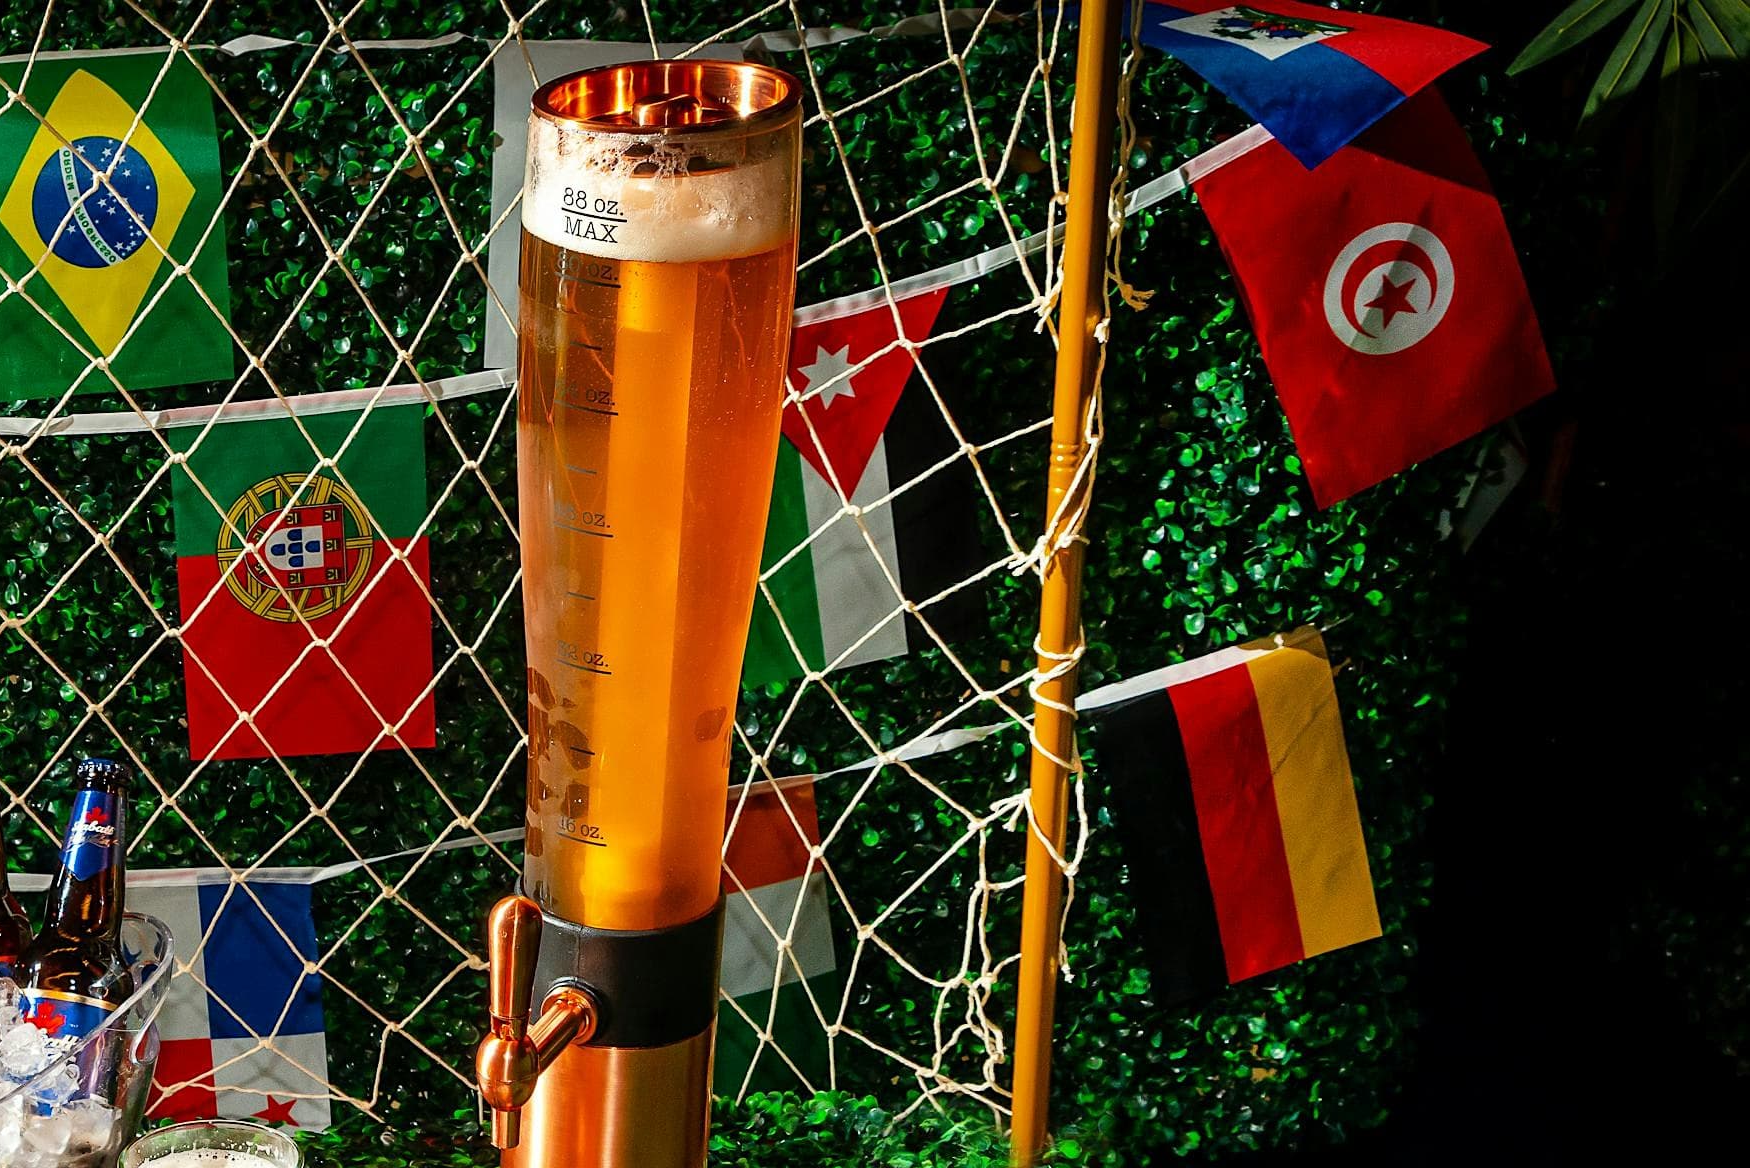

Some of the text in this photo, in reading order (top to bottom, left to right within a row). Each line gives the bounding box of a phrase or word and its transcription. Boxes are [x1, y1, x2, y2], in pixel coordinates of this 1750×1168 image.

[563, 187, 587, 209] 88
[563, 215, 618, 244] MAX
[71, 820, 115, 835] Labatt
